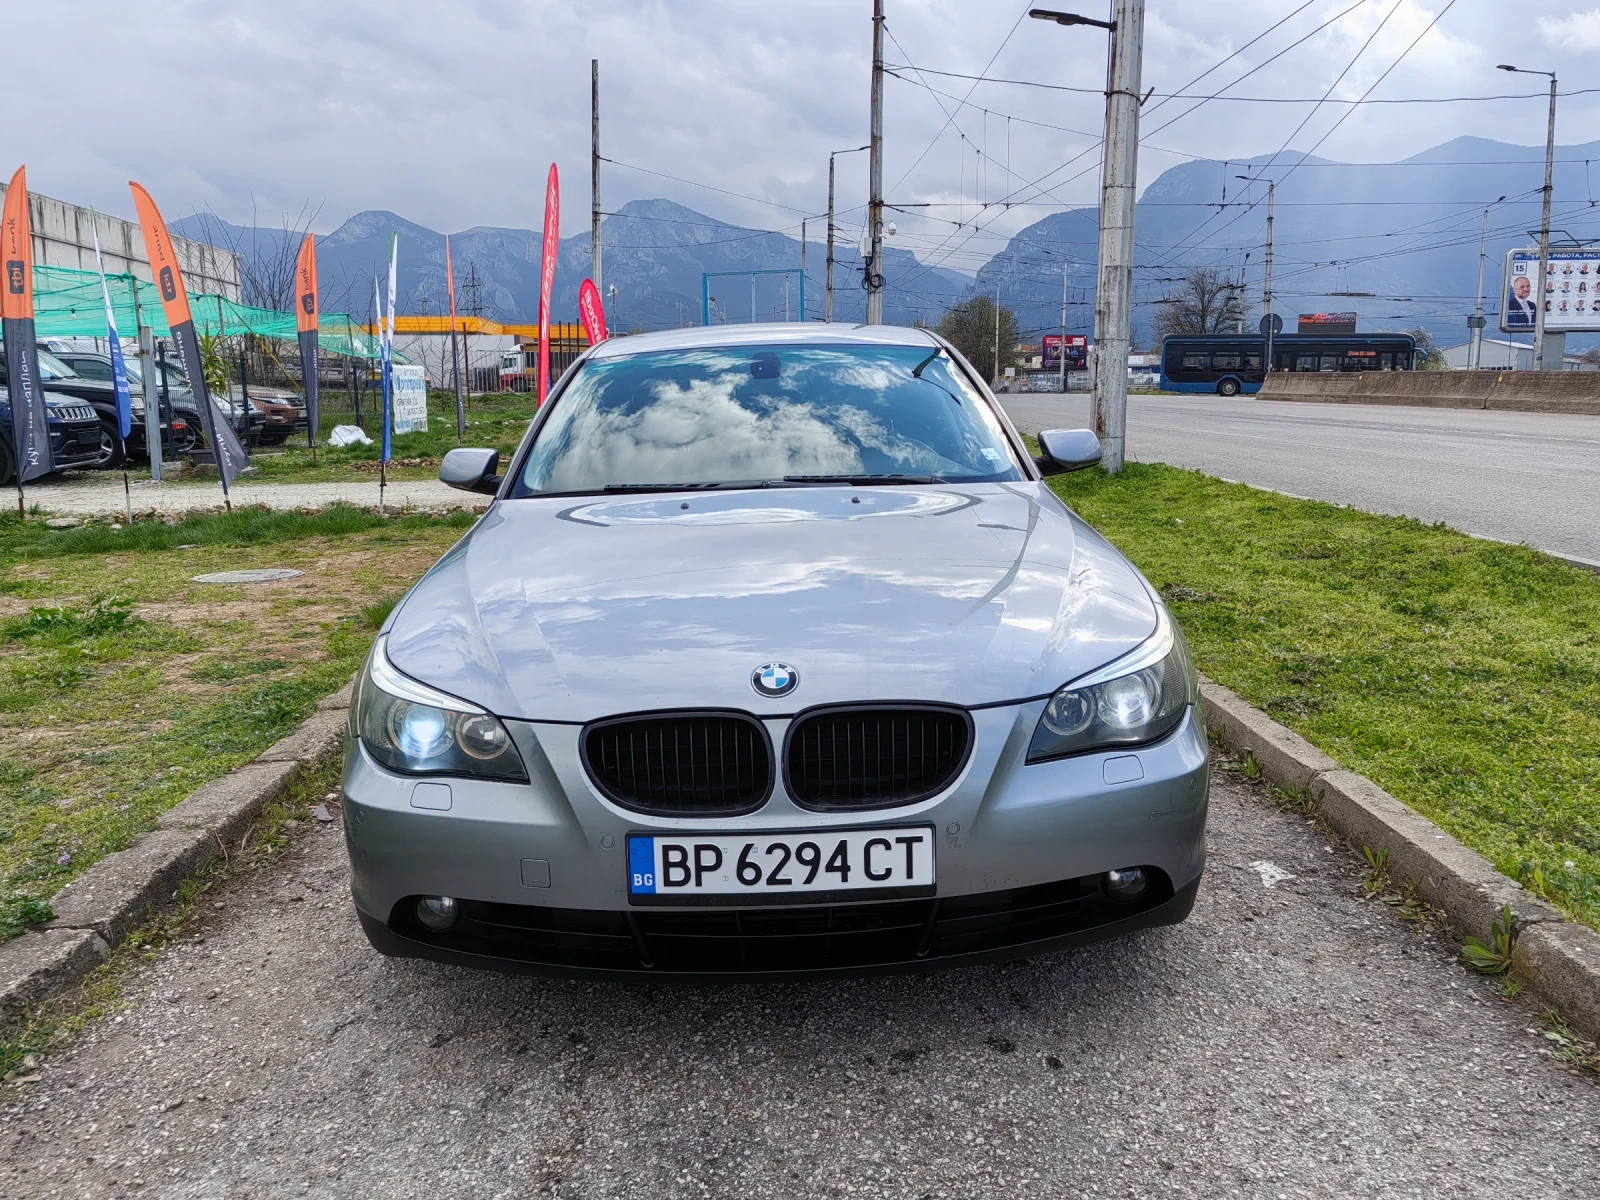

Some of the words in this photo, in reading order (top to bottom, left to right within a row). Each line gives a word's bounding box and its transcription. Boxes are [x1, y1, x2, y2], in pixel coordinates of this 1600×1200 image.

[11, 267, 23, 288] tbi
[661, 844, 723, 887] BP
[736, 840, 851, 886] 6294
[863, 836, 923, 881] CT
[633, 873, 653, 886] BG
